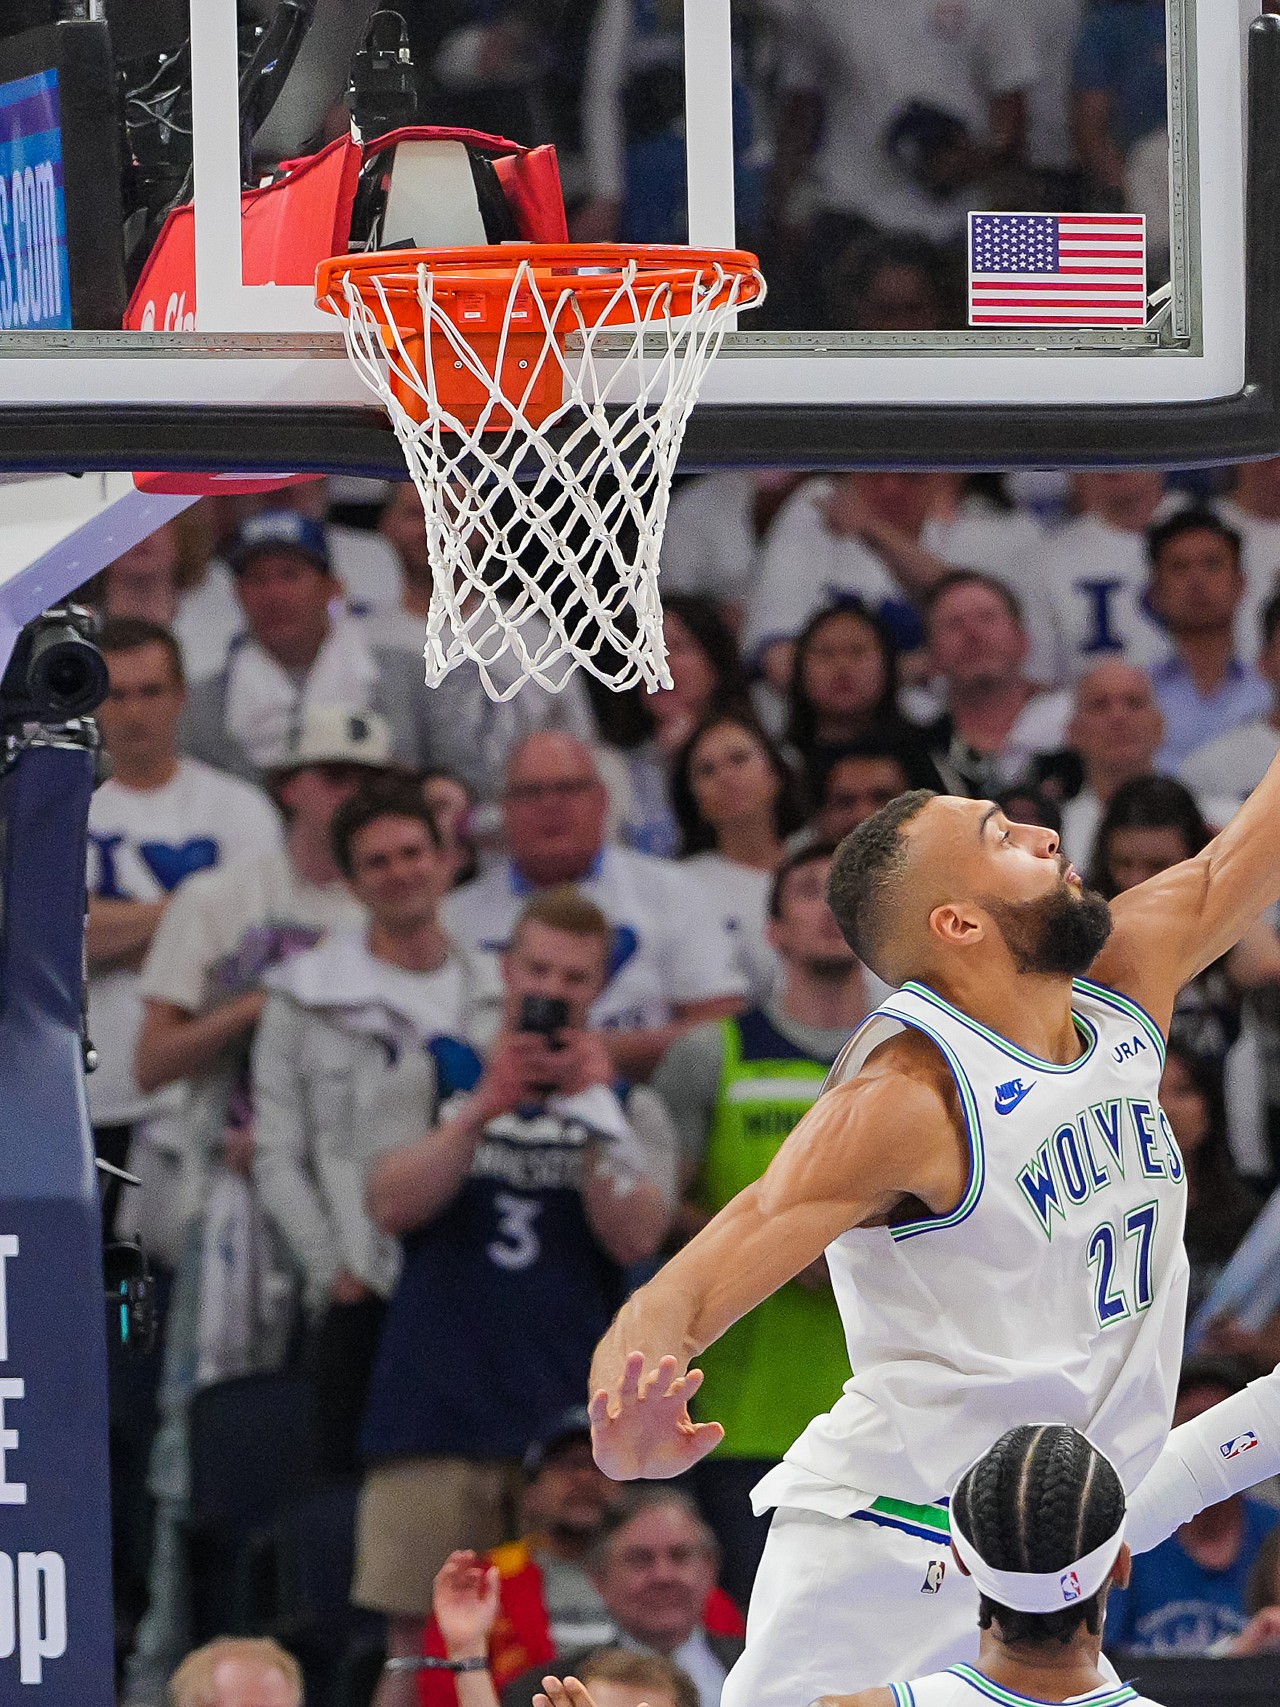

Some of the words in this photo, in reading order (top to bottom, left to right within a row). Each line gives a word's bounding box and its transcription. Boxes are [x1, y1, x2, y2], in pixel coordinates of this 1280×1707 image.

[1074, 578, 1123, 653] I
[1015, 1097, 1185, 1243] WOLVES
[488, 1194, 541, 1269] 3
[1087, 1199, 1159, 1329] 27
